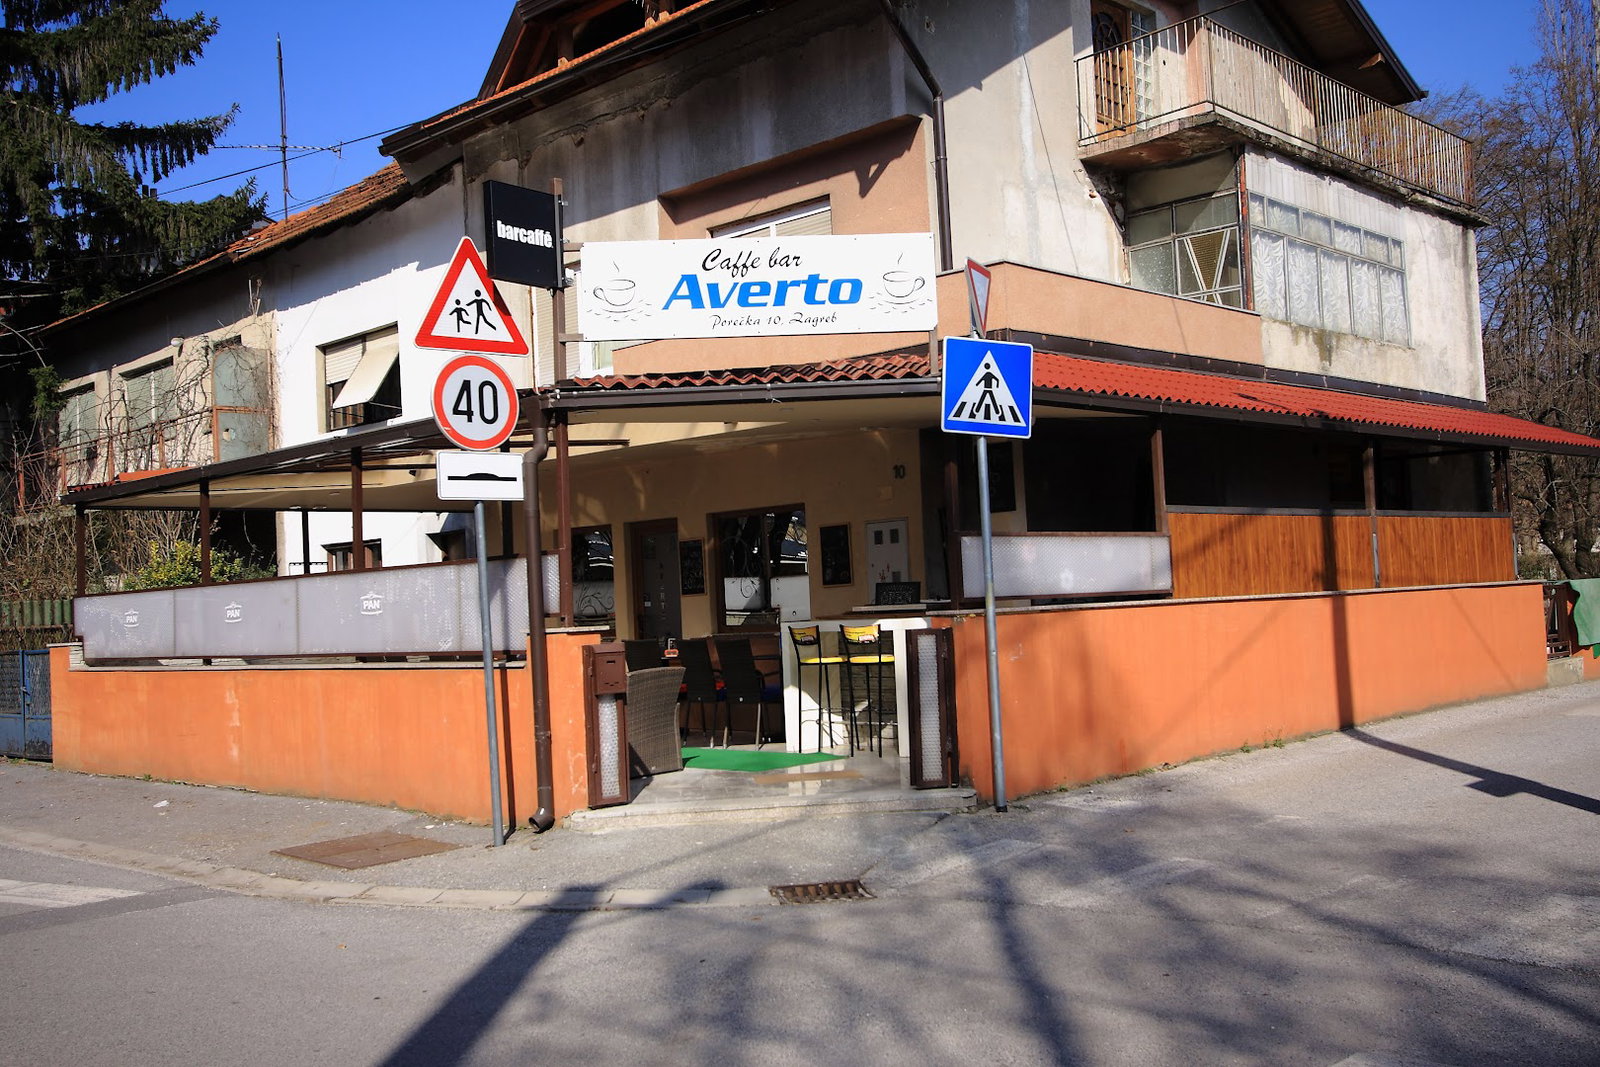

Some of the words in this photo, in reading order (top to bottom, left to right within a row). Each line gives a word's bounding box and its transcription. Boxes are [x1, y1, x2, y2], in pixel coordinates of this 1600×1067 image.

[701, 248, 761, 278] Caffe
[768, 246, 802, 269] bar
[661, 273, 863, 310] Averto
[767, 315, 784, 326] 10,
[789, 311, 838, 328] Zagreb
[452, 379, 499, 425] 40
[892, 464, 906, 479] 10
[226, 608, 241, 618] PAN
[363, 599, 380, 610] PAN
